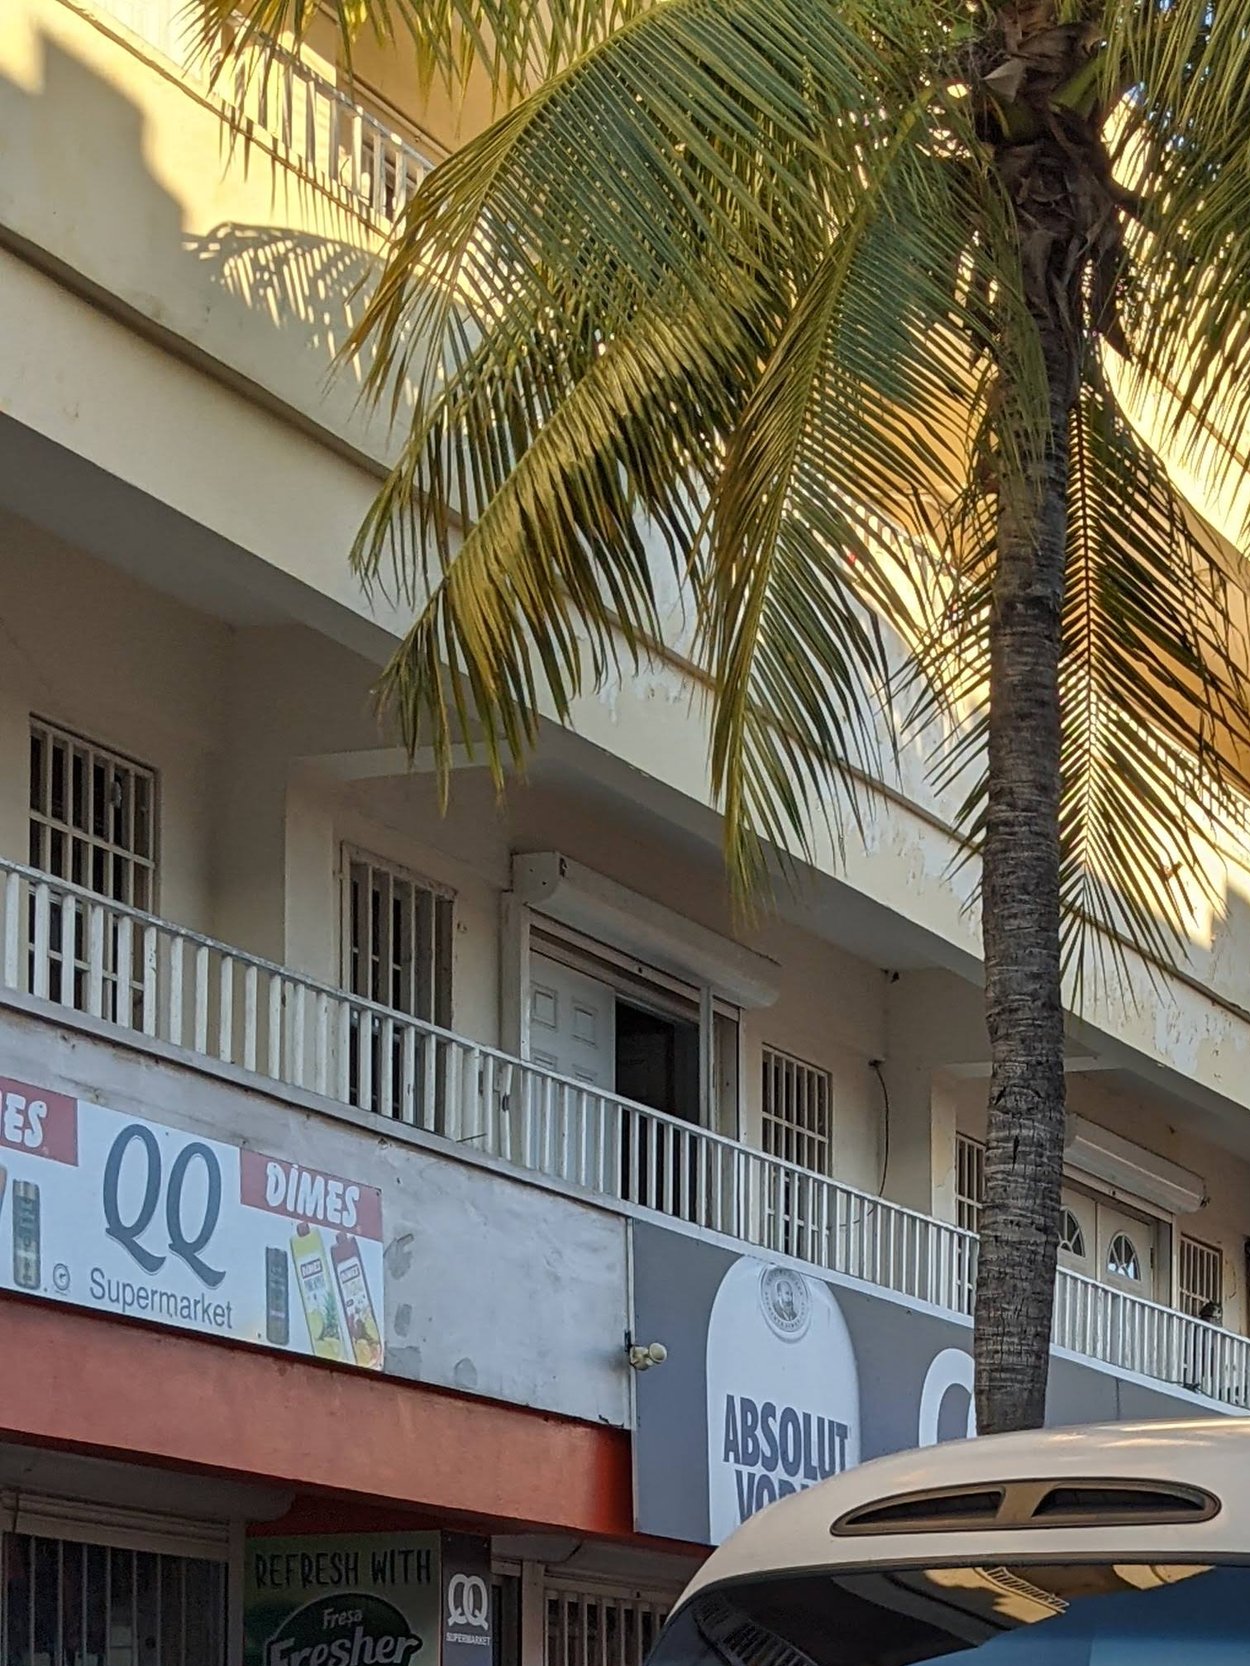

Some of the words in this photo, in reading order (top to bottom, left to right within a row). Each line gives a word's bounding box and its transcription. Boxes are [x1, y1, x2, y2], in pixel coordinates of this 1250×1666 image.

[0, 1090, 47, 1148] ES
[103, 1123, 226, 1288] QQ
[89, 1265, 233, 1330] Supermarket
[723, 1394, 848, 1481] ABSOLUT
[254, 1551, 359, 1588] REFRESH
[371, 1549, 431, 1585] WITH
[448, 1573, 489, 1630] QQ
[446, 1631, 490, 1646] SUPERMARKET
